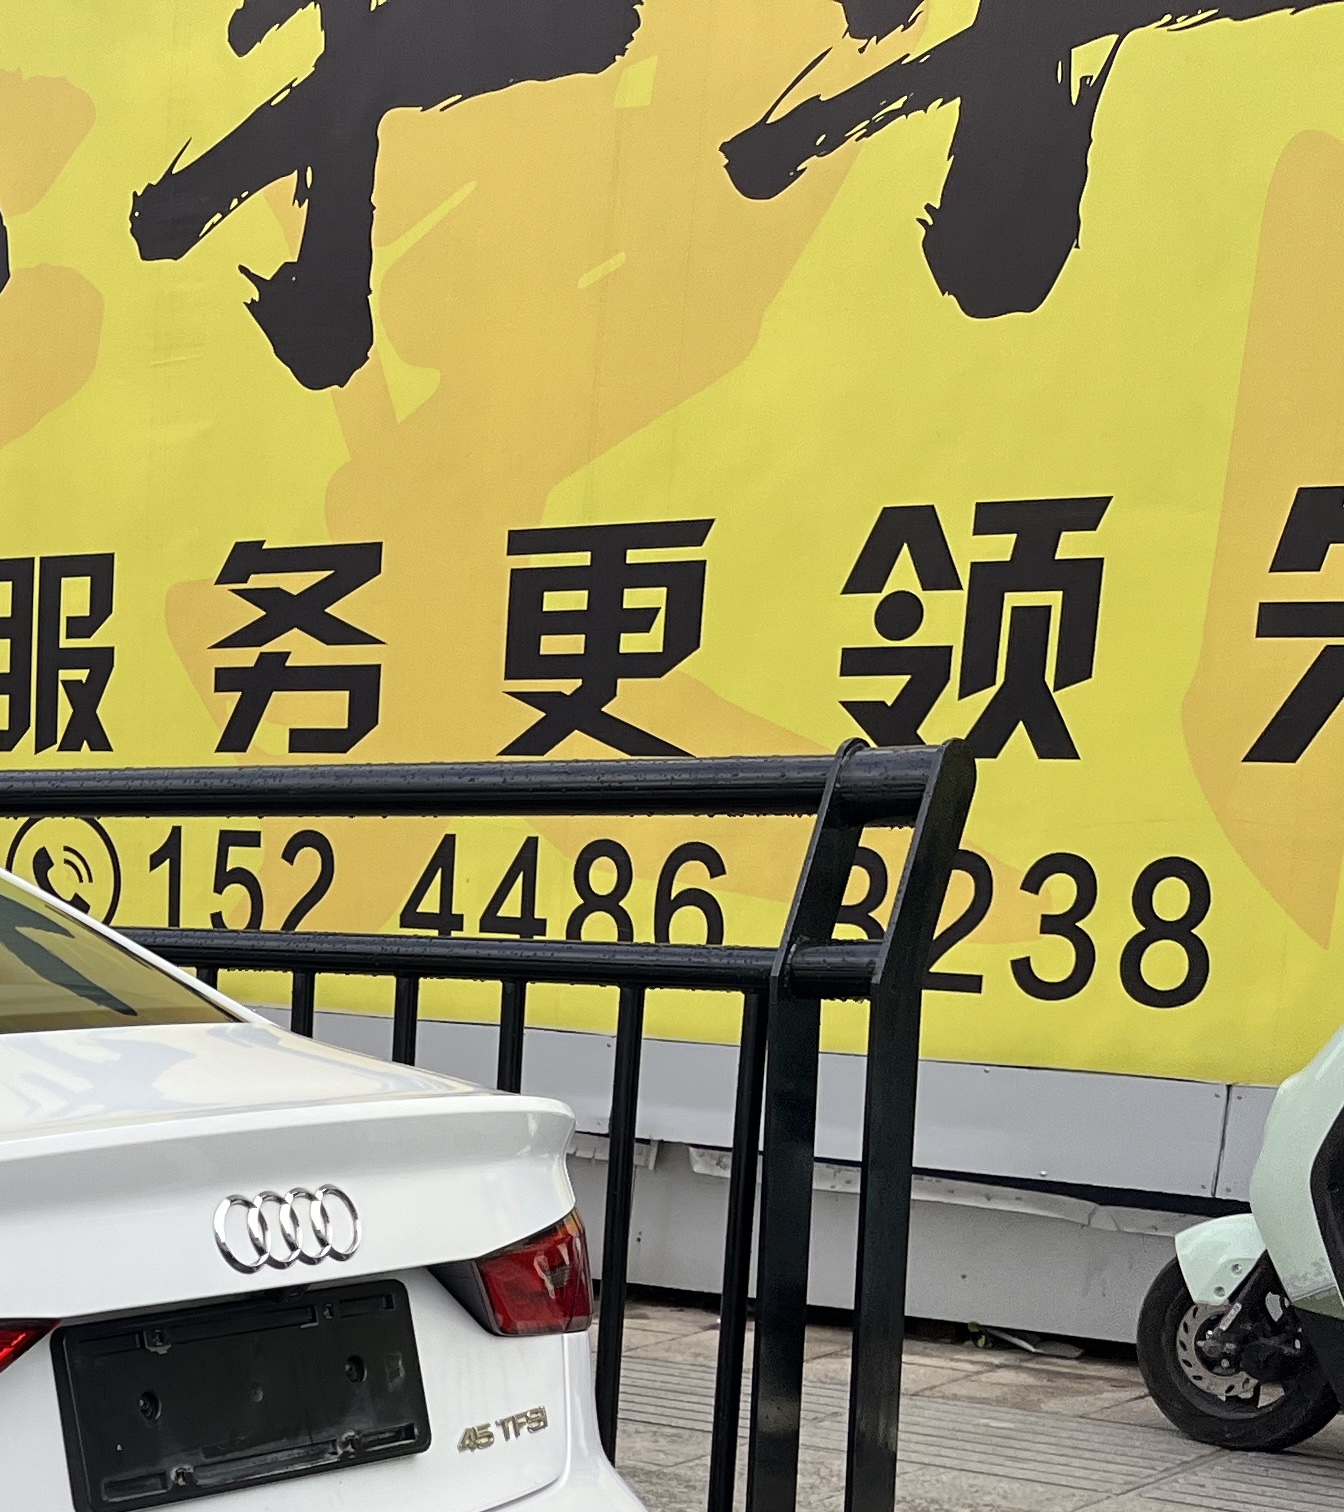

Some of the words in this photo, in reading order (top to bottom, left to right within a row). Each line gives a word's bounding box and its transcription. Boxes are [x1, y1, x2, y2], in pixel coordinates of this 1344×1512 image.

[148, 825, 336, 931] 152
[401, 832, 727, 944] 4486
[457, 1423, 495, 1453] 45
[495, 1405, 548, 1442] TFSI
